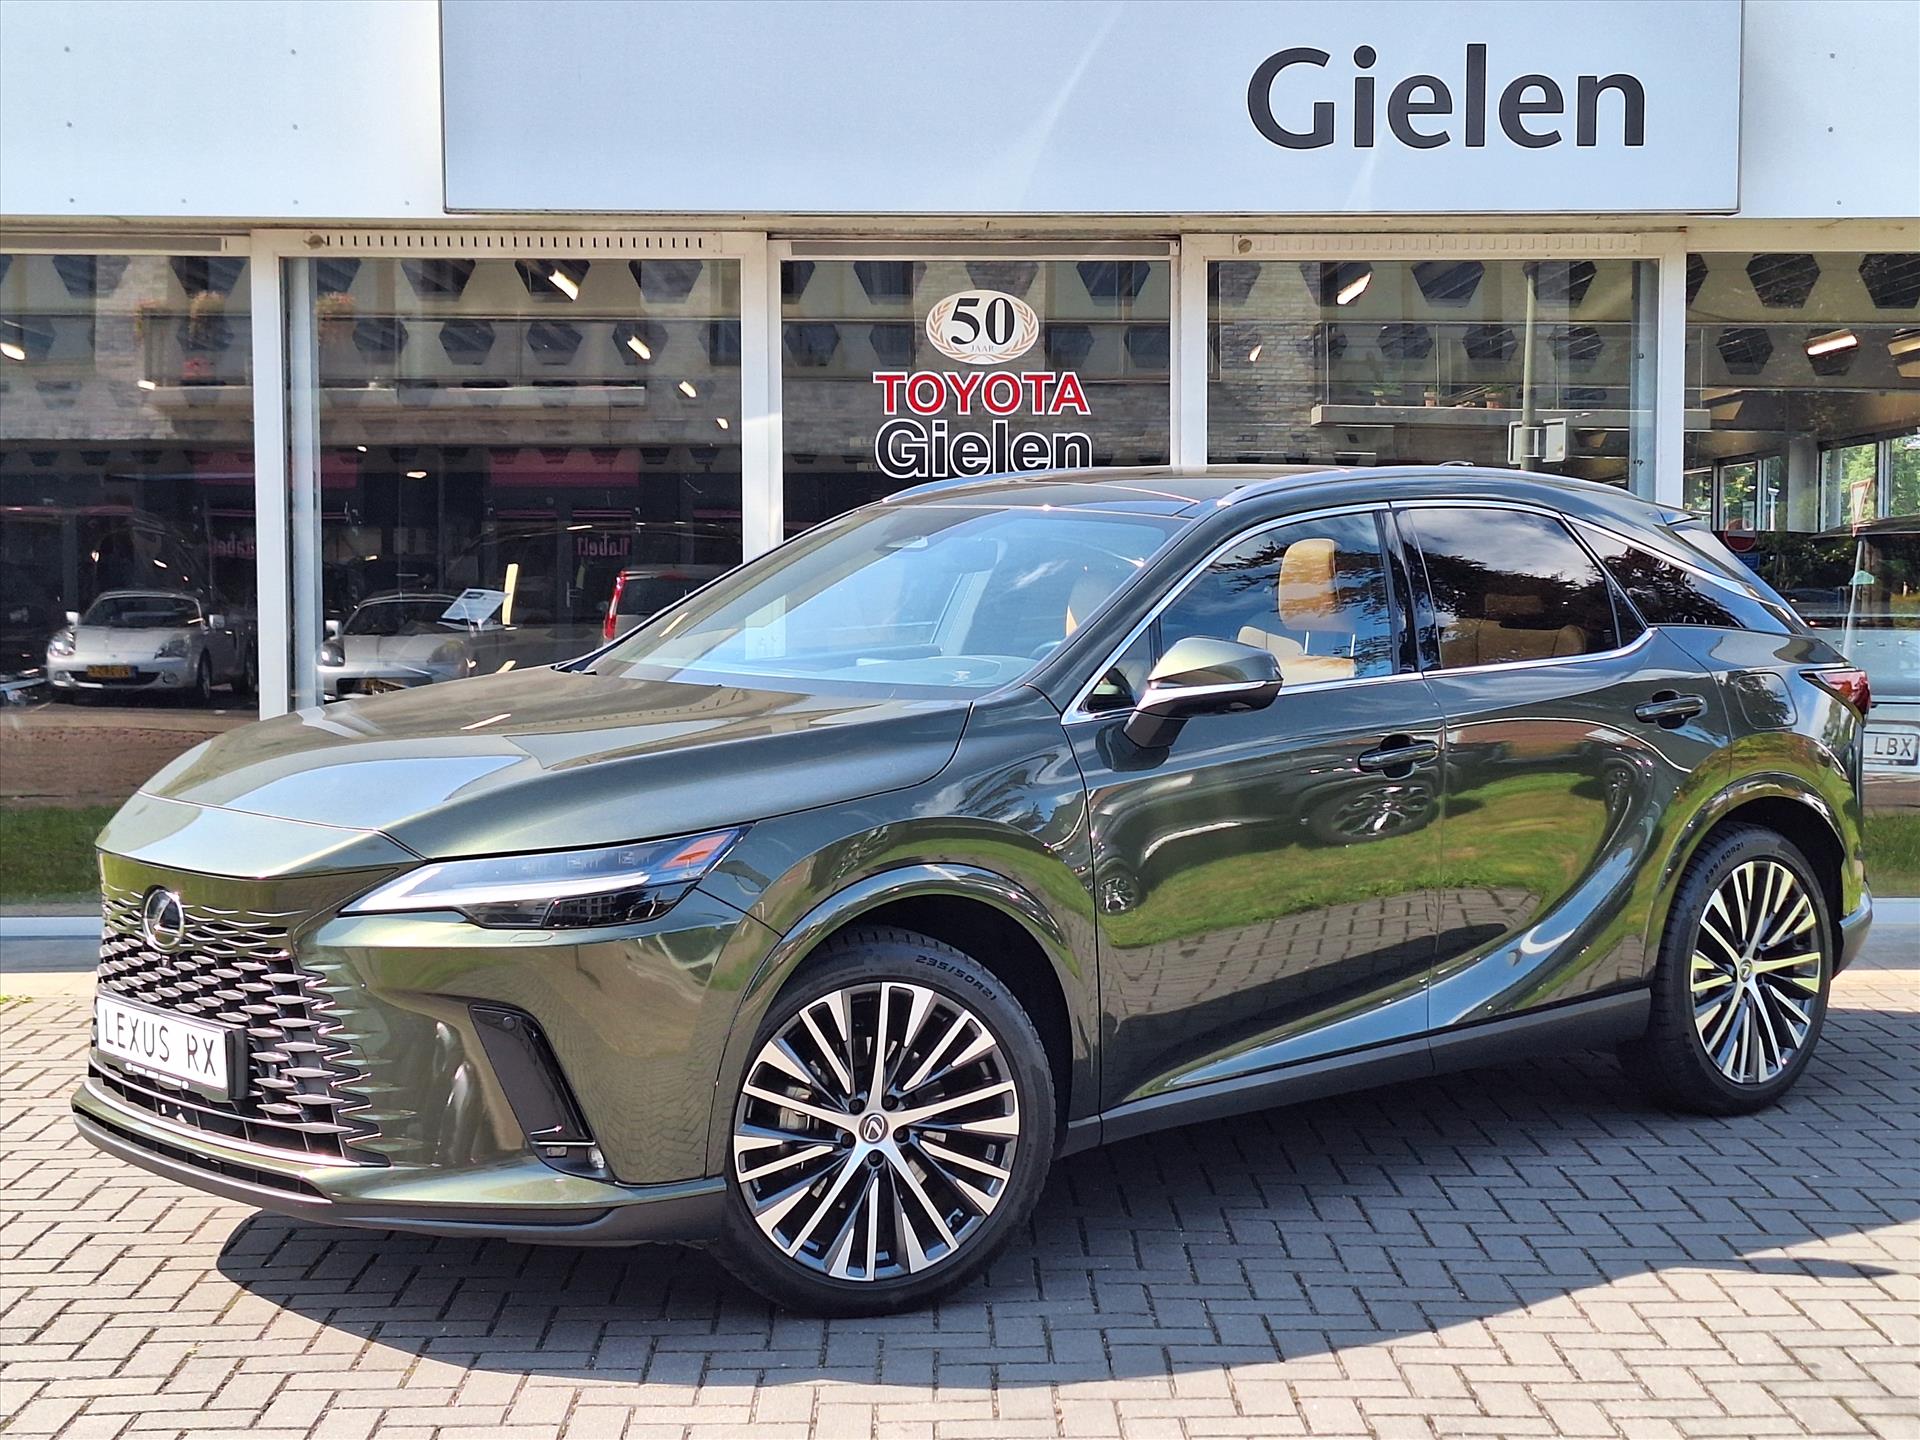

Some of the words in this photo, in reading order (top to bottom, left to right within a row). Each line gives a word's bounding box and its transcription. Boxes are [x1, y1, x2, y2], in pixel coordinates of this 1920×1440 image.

[1247, 43, 1646, 149] Gielen
[951, 297, 1016, 346] 50
[873, 371, 1091, 416] TOYOTA
[875, 418, 1094, 479] Gielen
[1873, 736, 1912, 757] LBX
[915, 954, 998, 1001] 235/50R21
[104, 1008, 170, 1063] LEXUS
[186, 1032, 216, 1077] RX
